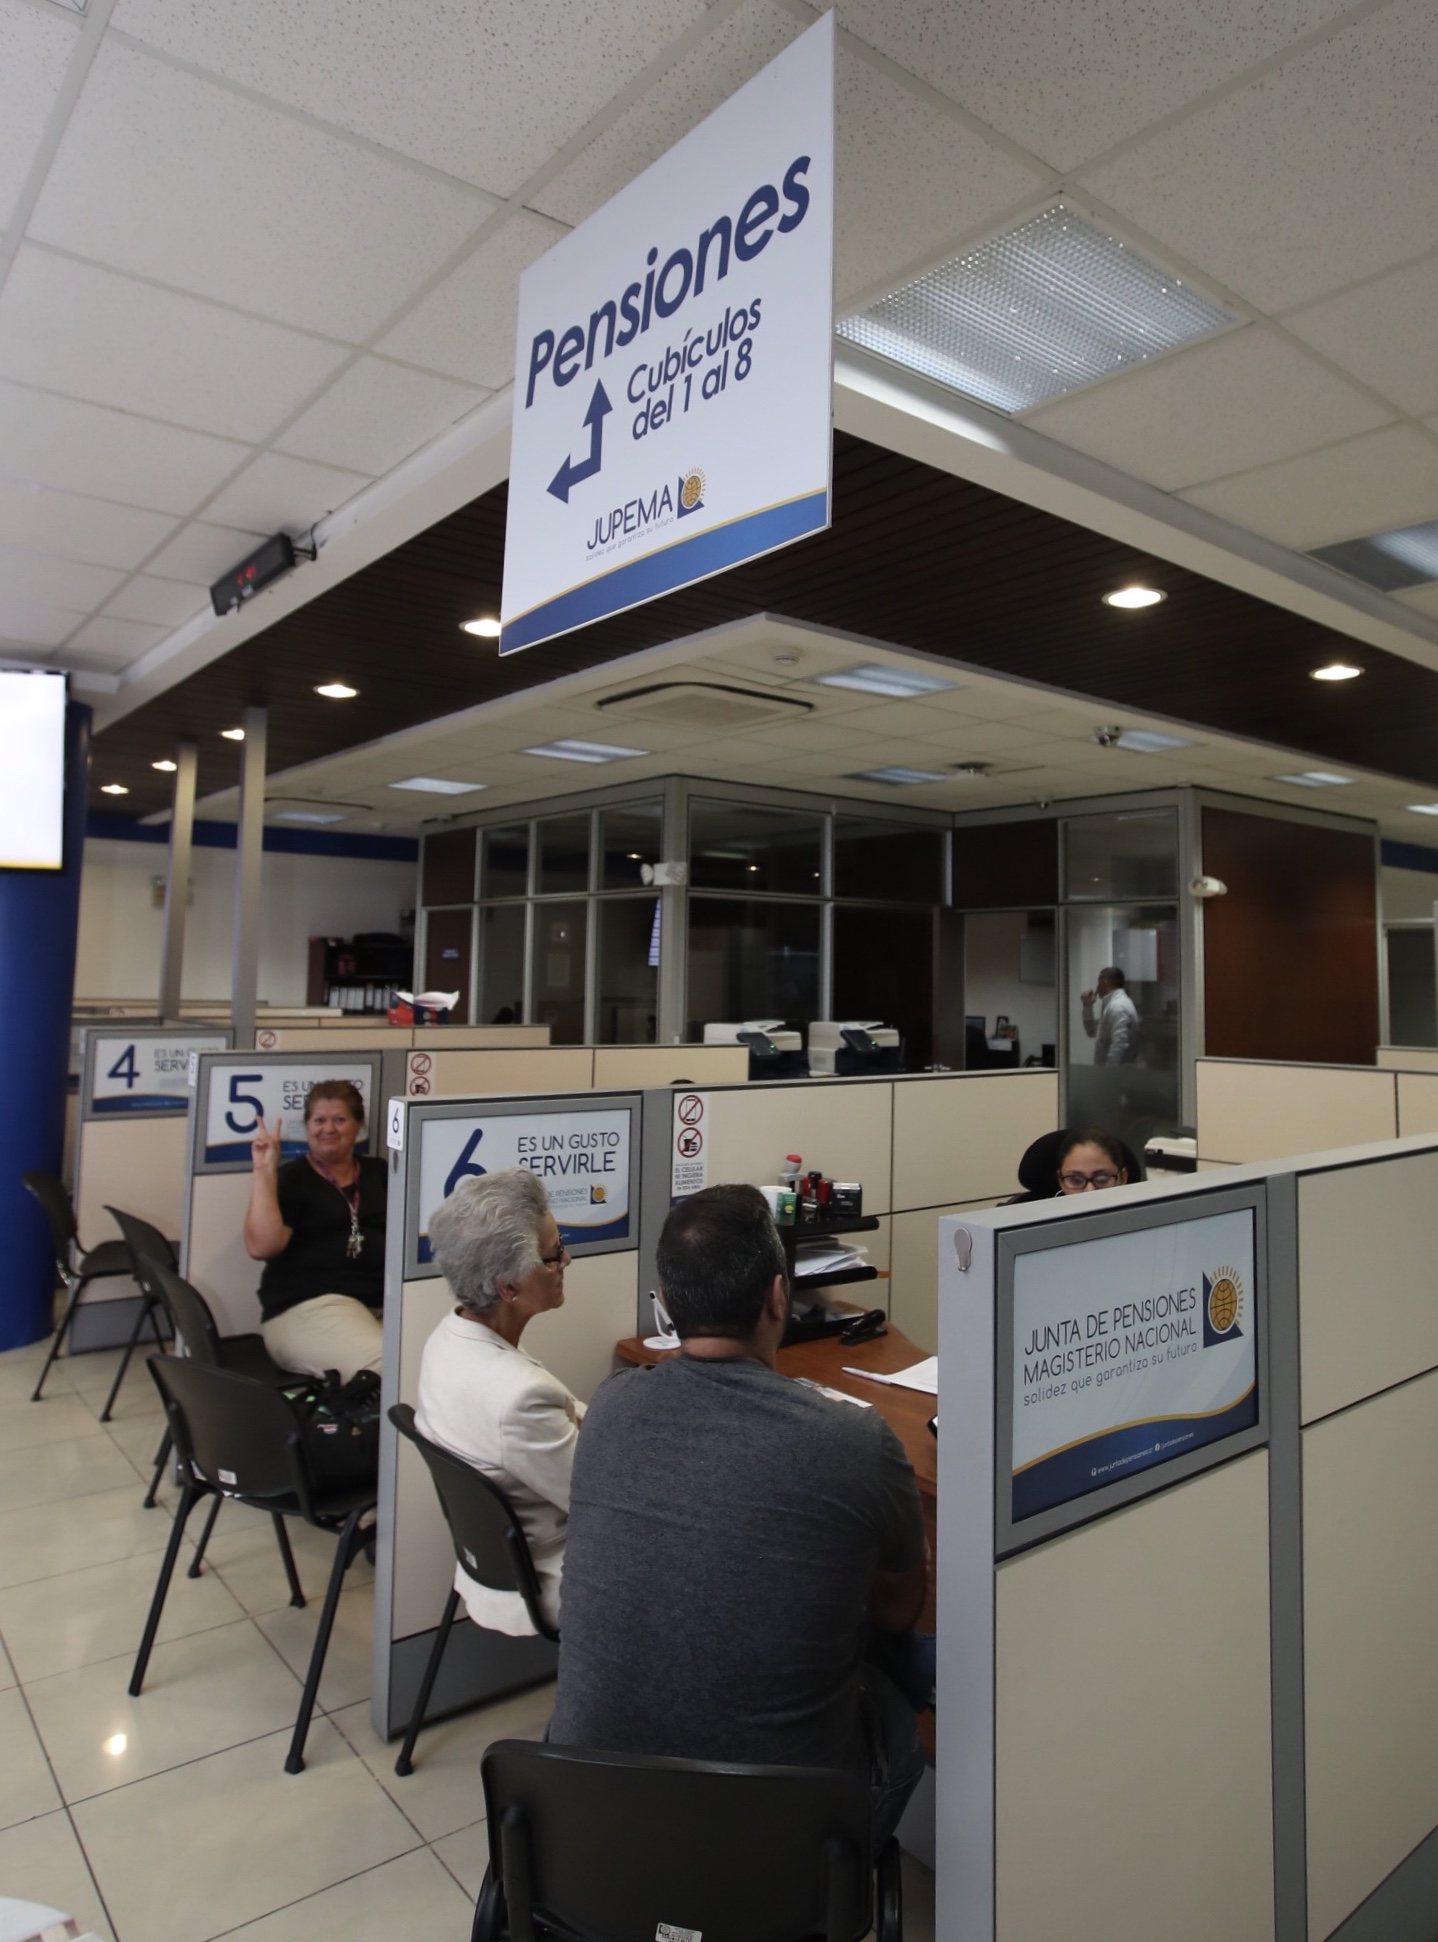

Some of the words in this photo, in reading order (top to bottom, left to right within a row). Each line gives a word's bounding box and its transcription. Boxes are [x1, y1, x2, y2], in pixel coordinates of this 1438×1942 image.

[525, 155, 811, 409] Pensiones
[627, 298, 762, 404] Cubículos
[632, 384, 673, 440] del
[683, 374, 692, 412] 1
[702, 352, 728, 400] al
[734, 338, 752, 381] 8
[587, 484, 673, 550] JUPEMA
[107, 1044, 140, 1089] 4
[154, 1060, 189, 1072] SERV
[283, 1081, 298, 1093] ES
[225, 1074, 264, 1134] 5
[392, 1107, 400, 1133] 6
[518, 1136, 537, 1153] ES
[542, 1135, 564, 1151] UN
[569, 1131, 620, 1150] GUSTO
[555, 1187, 588, 1197] PENSIONES
[1024, 1319, 1081, 1355] JUNTA
[1087, 1310, 1108, 1339] DE
[1114, 1288, 1196, 1331] PENSIONES
[1024, 1338, 1120, 1385] MAGISTERIO
[1126, 1317, 1196, 1354] NACIONAL
[1023, 1383, 1066, 1406] solidez
[1071, 1375, 1092, 1394] que
[1097, 1359, 1148, 1387] garantiza
[1152, 1353, 1163, 1365] su
[1167, 1343, 1197, 1360] futuro
